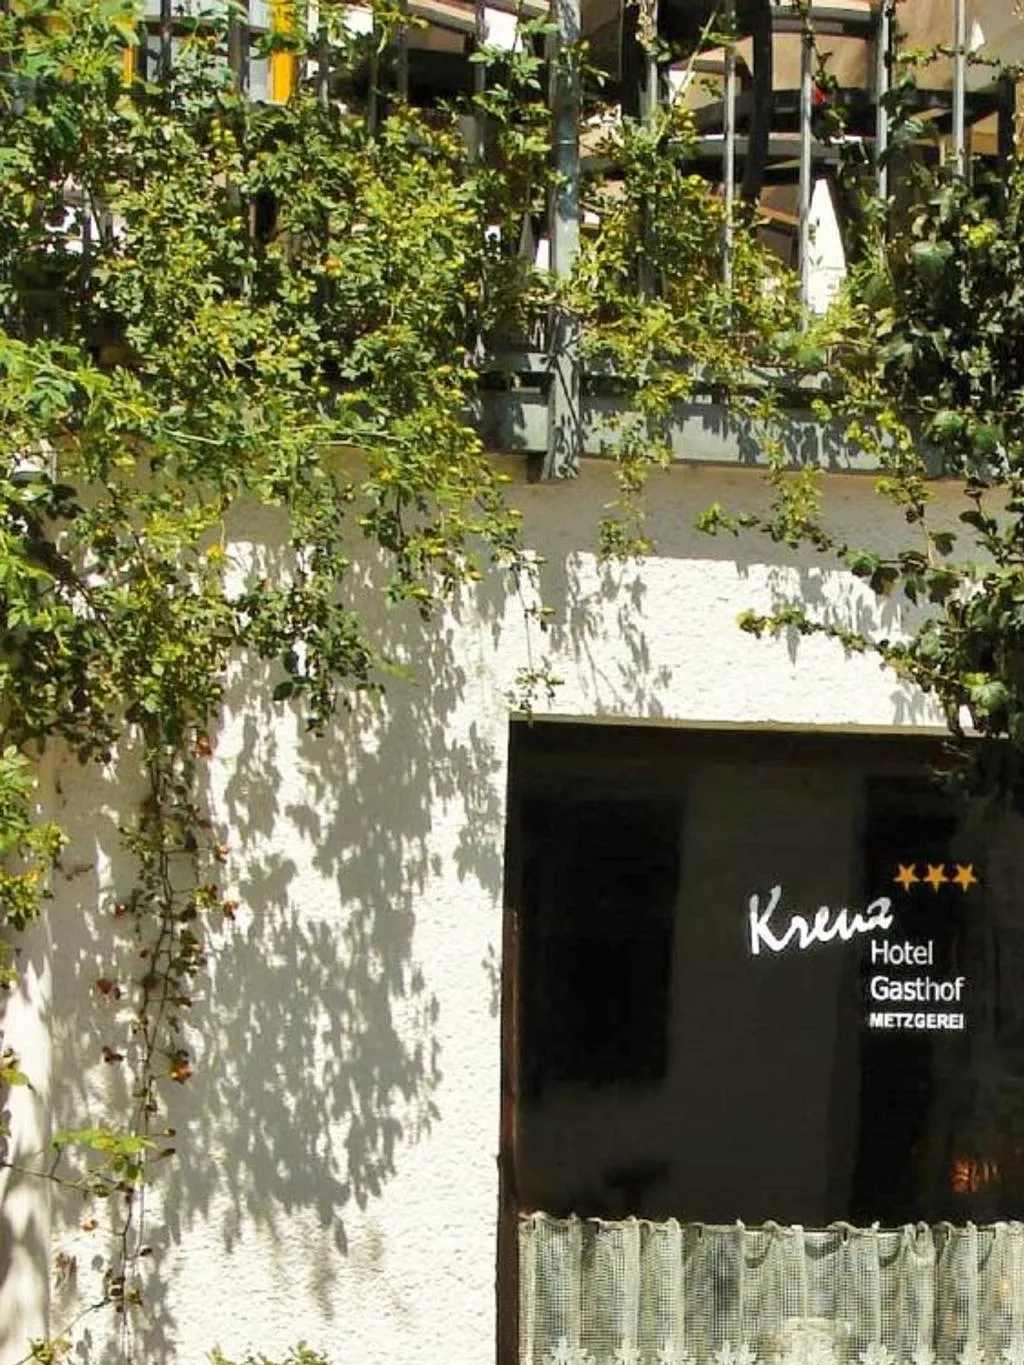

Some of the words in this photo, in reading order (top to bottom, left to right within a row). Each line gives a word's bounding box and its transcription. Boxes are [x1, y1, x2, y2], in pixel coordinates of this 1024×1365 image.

[871, 939, 933, 965] Hotel
[870, 976, 965, 1001] Gasthof
[869, 1013, 965, 1029] METZGEREI
